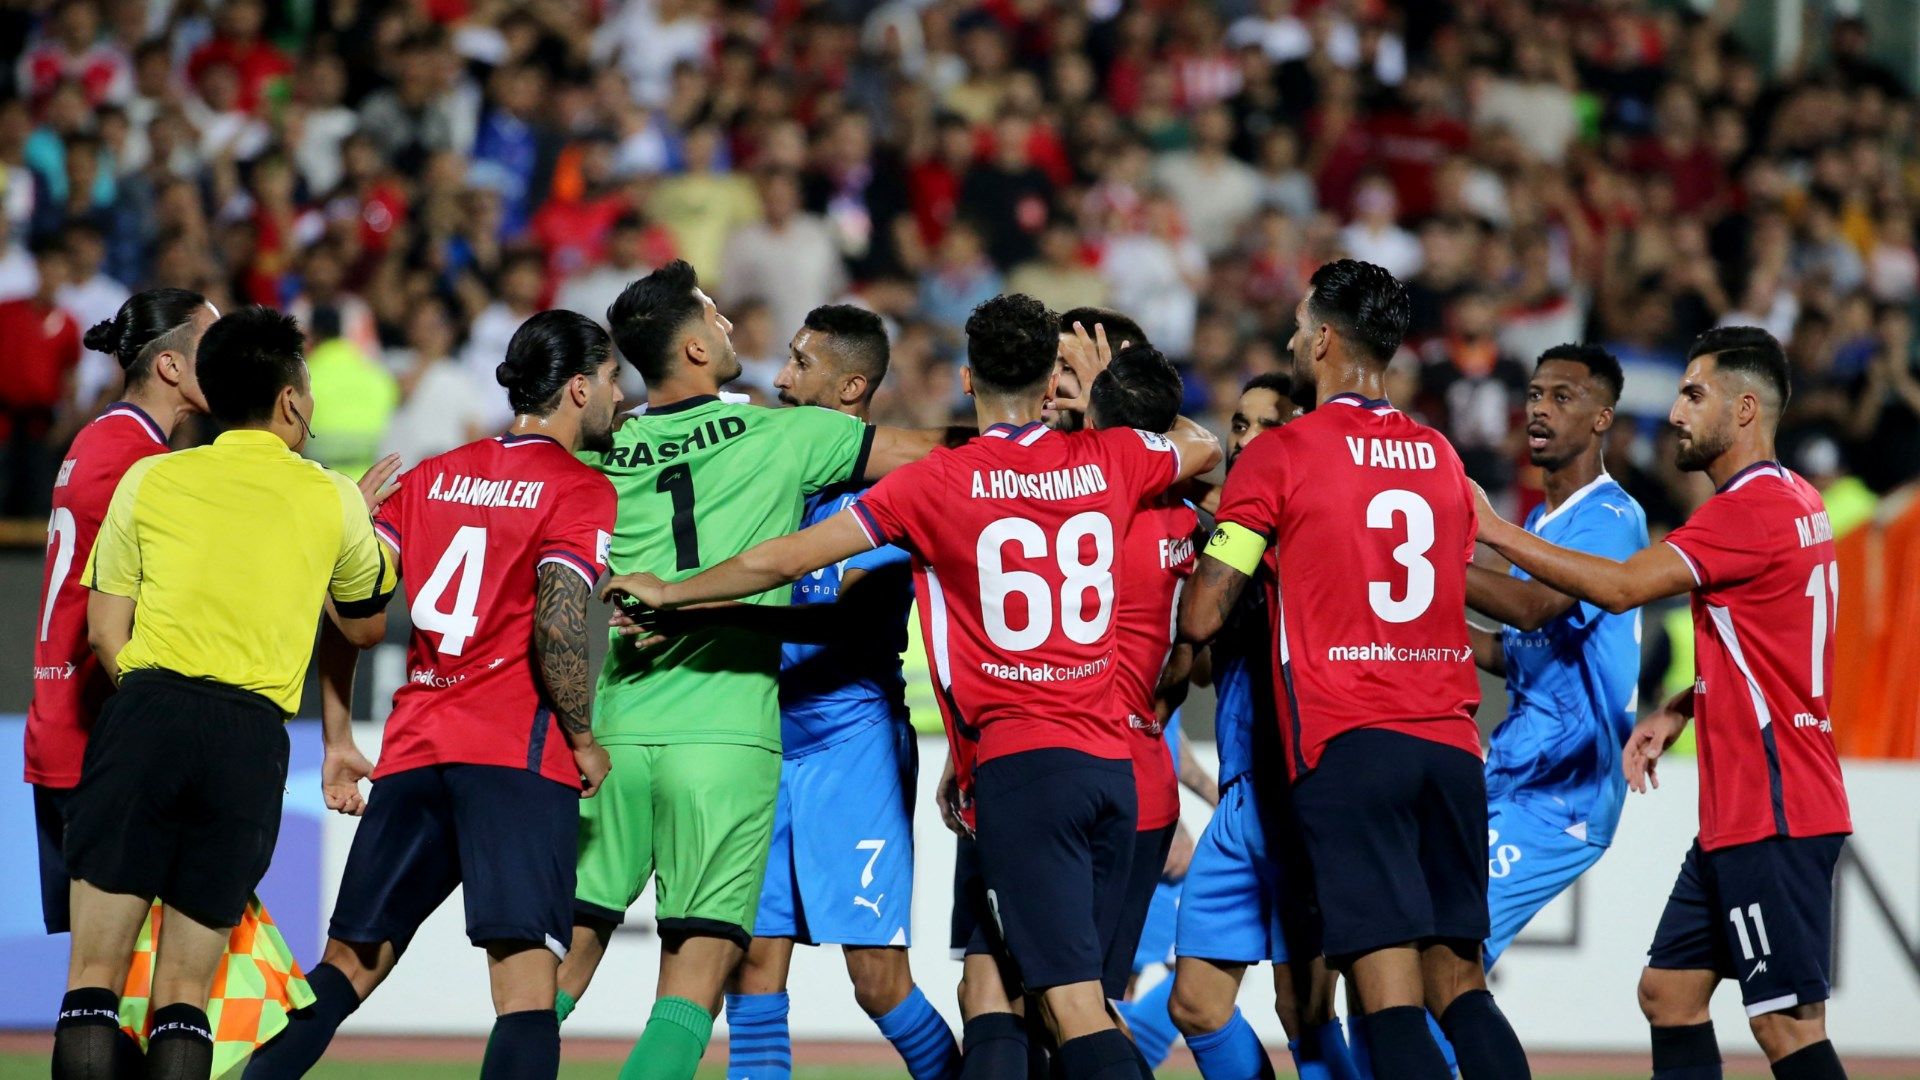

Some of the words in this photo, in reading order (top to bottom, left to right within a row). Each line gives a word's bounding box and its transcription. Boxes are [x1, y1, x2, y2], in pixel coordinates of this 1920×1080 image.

[604, 416, 747, 468] RASHID
[1346, 436, 1436, 470] VAHID
[427, 472, 545, 509] A.JANMALEKI
[971, 463, 1108, 501] A.HOUSHMAND
[656, 462, 701, 573] 1
[976, 511, 1115, 652] 68
[1366, 489, 1435, 624] 3
[411, 525, 487, 657] 4
[855, 839, 886, 889] 7
[1729, 902, 1772, 960] 11
[60, 1008, 115, 1020] KELME
[158, 1021, 209, 1038] KELME
